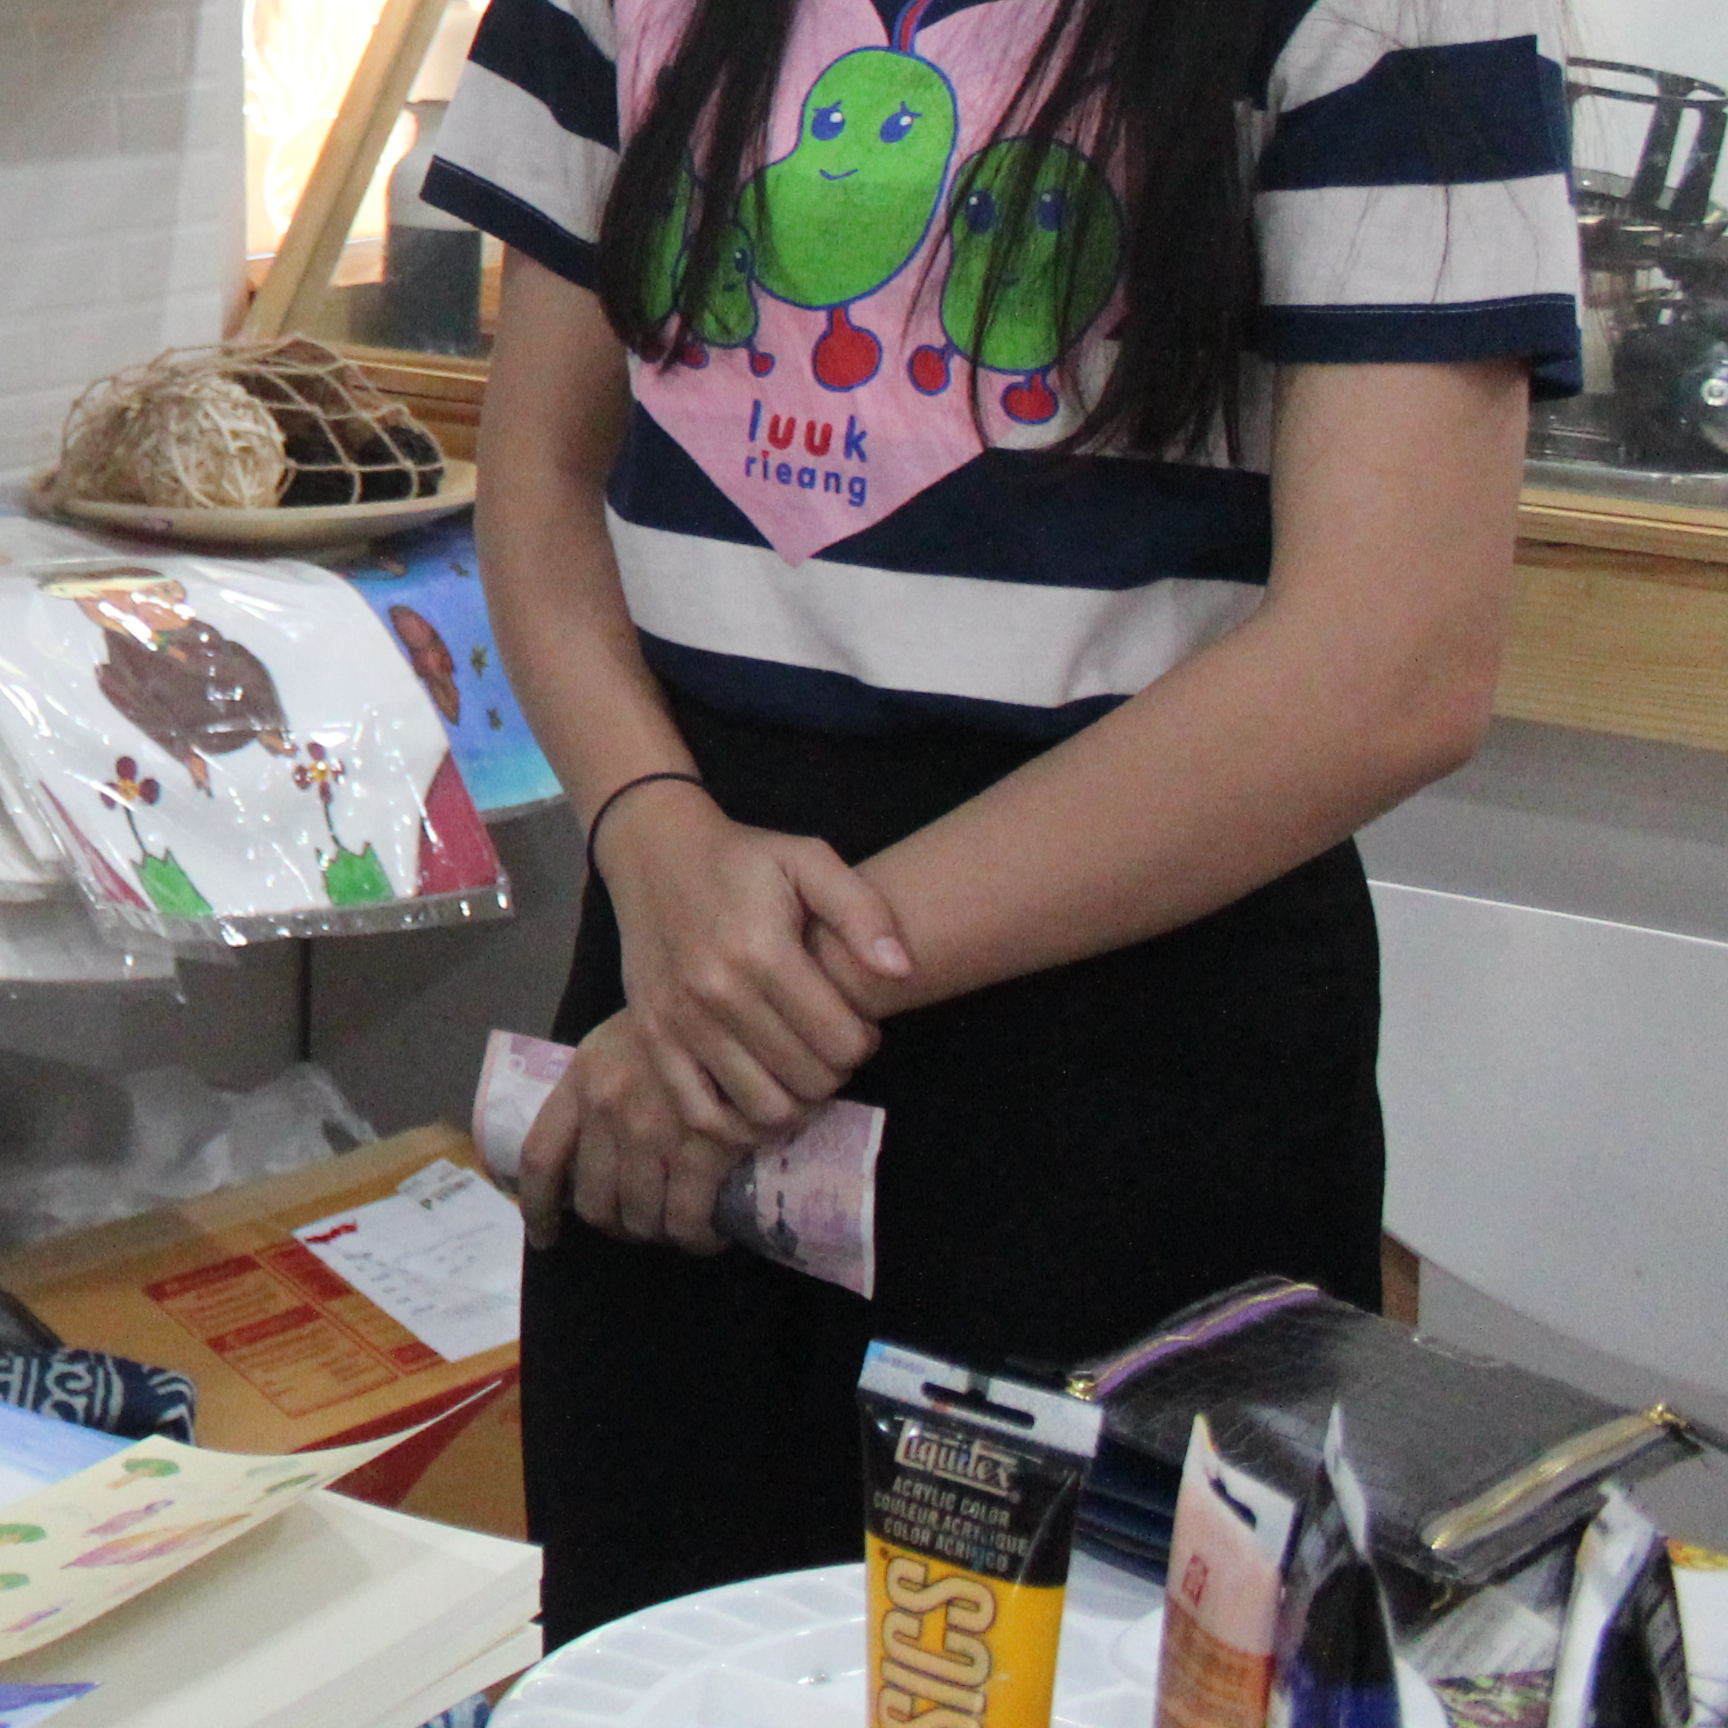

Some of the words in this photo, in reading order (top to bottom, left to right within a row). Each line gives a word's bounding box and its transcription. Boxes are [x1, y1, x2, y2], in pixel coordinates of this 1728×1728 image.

[748, 398, 868, 463] luuk
[745, 450, 867, 507] rieang
[892, 1475, 957, 1512] ACRYLIC
[959, 1499, 1011, 1528] COLOR
[883, 1517, 933, 1547] COLOR
